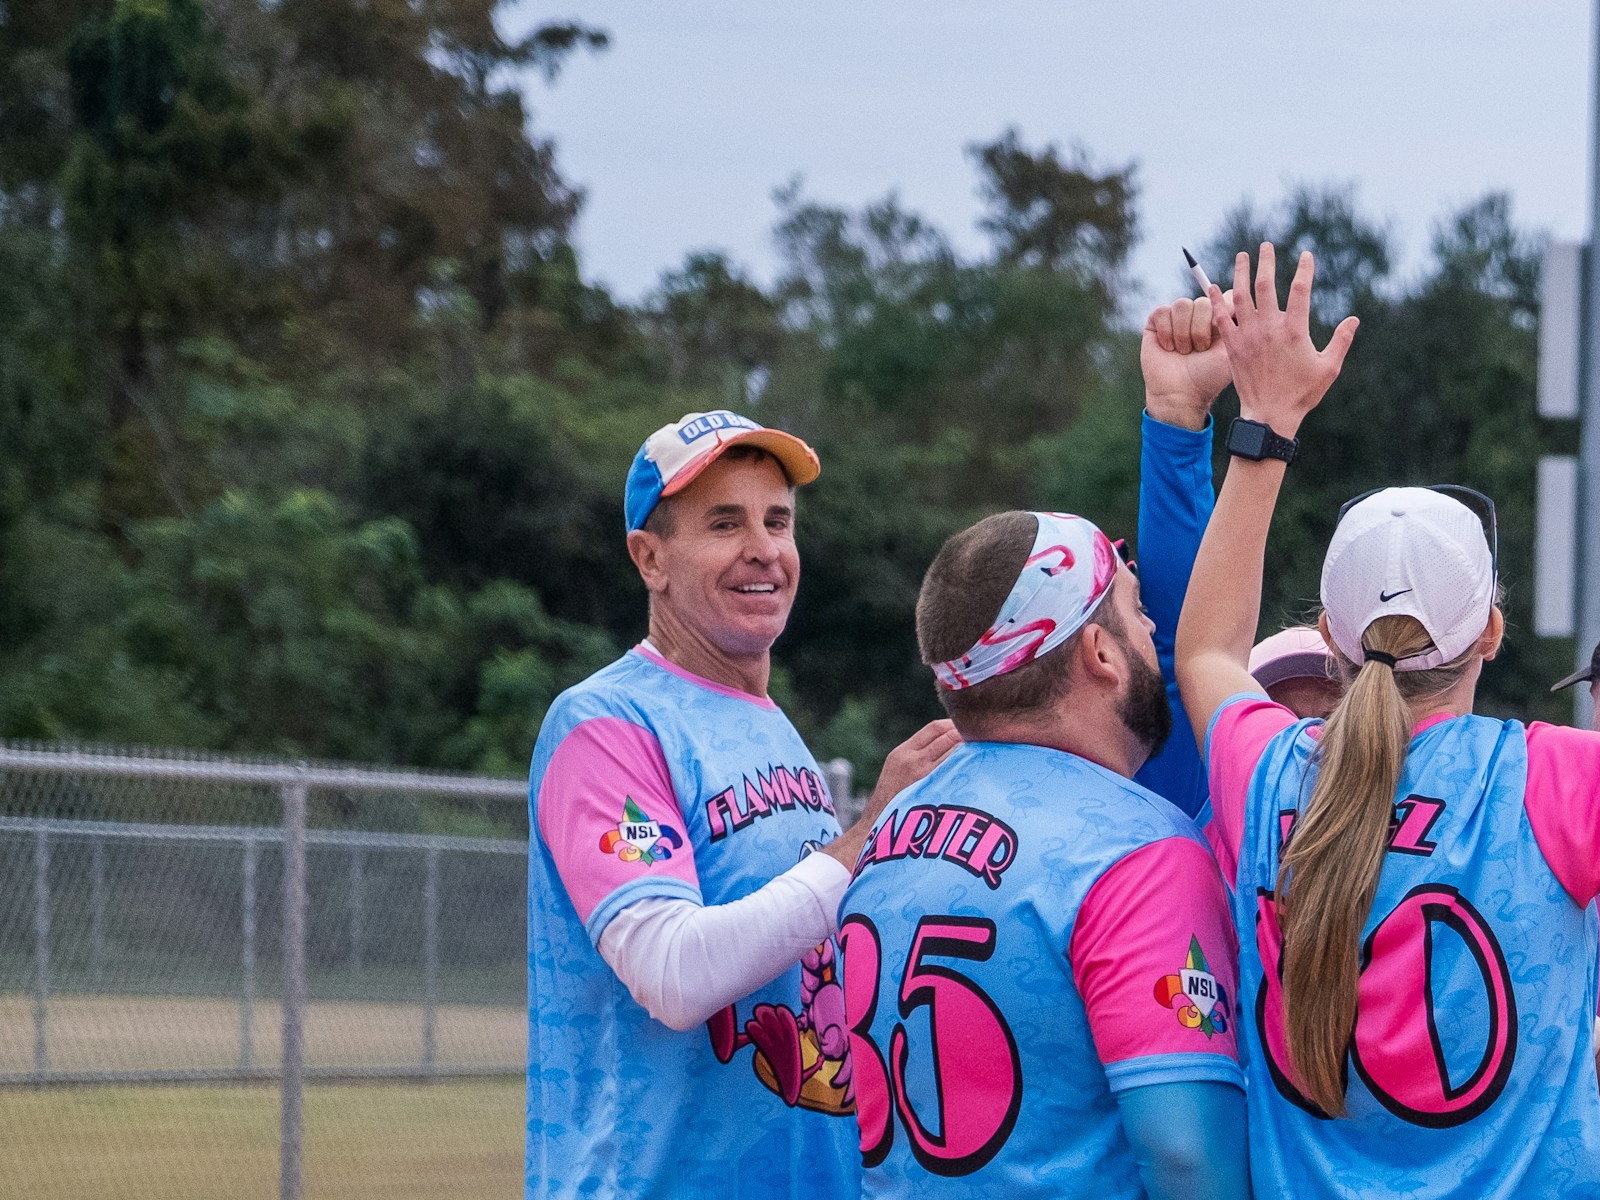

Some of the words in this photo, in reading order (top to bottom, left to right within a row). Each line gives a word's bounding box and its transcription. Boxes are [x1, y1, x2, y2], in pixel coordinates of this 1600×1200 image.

[683, 414, 724, 439] OLD
[626, 824, 658, 840] NSL
[1188, 976, 1216, 1000] NSL
